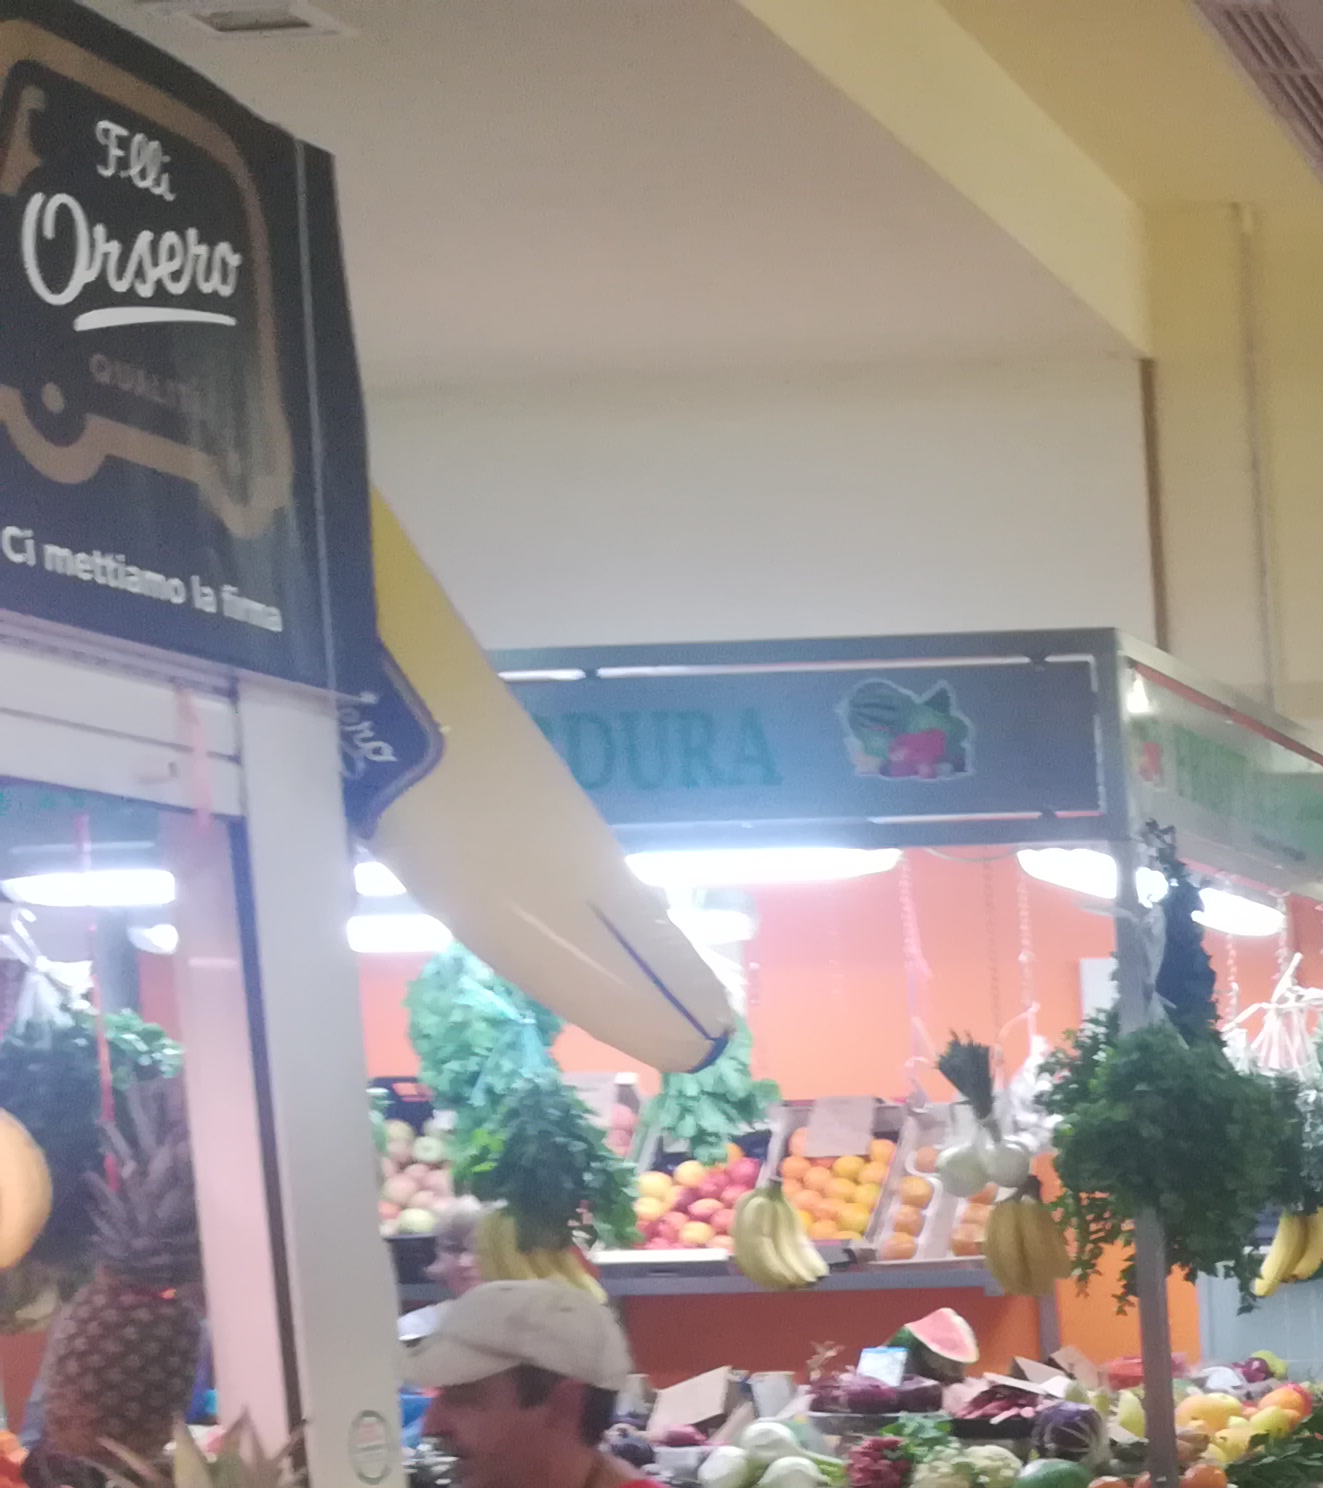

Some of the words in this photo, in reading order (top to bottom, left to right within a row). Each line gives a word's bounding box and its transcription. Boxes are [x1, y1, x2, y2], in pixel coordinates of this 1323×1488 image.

[21, 191, 243, 306] Orsero
[1, 525, 37, 567] Ci
[43, 543, 188, 605] mettiamo
[190, 574, 218, 614] la
[220, 583, 284, 633] firma
[532, 706, 784, 791] DURA
